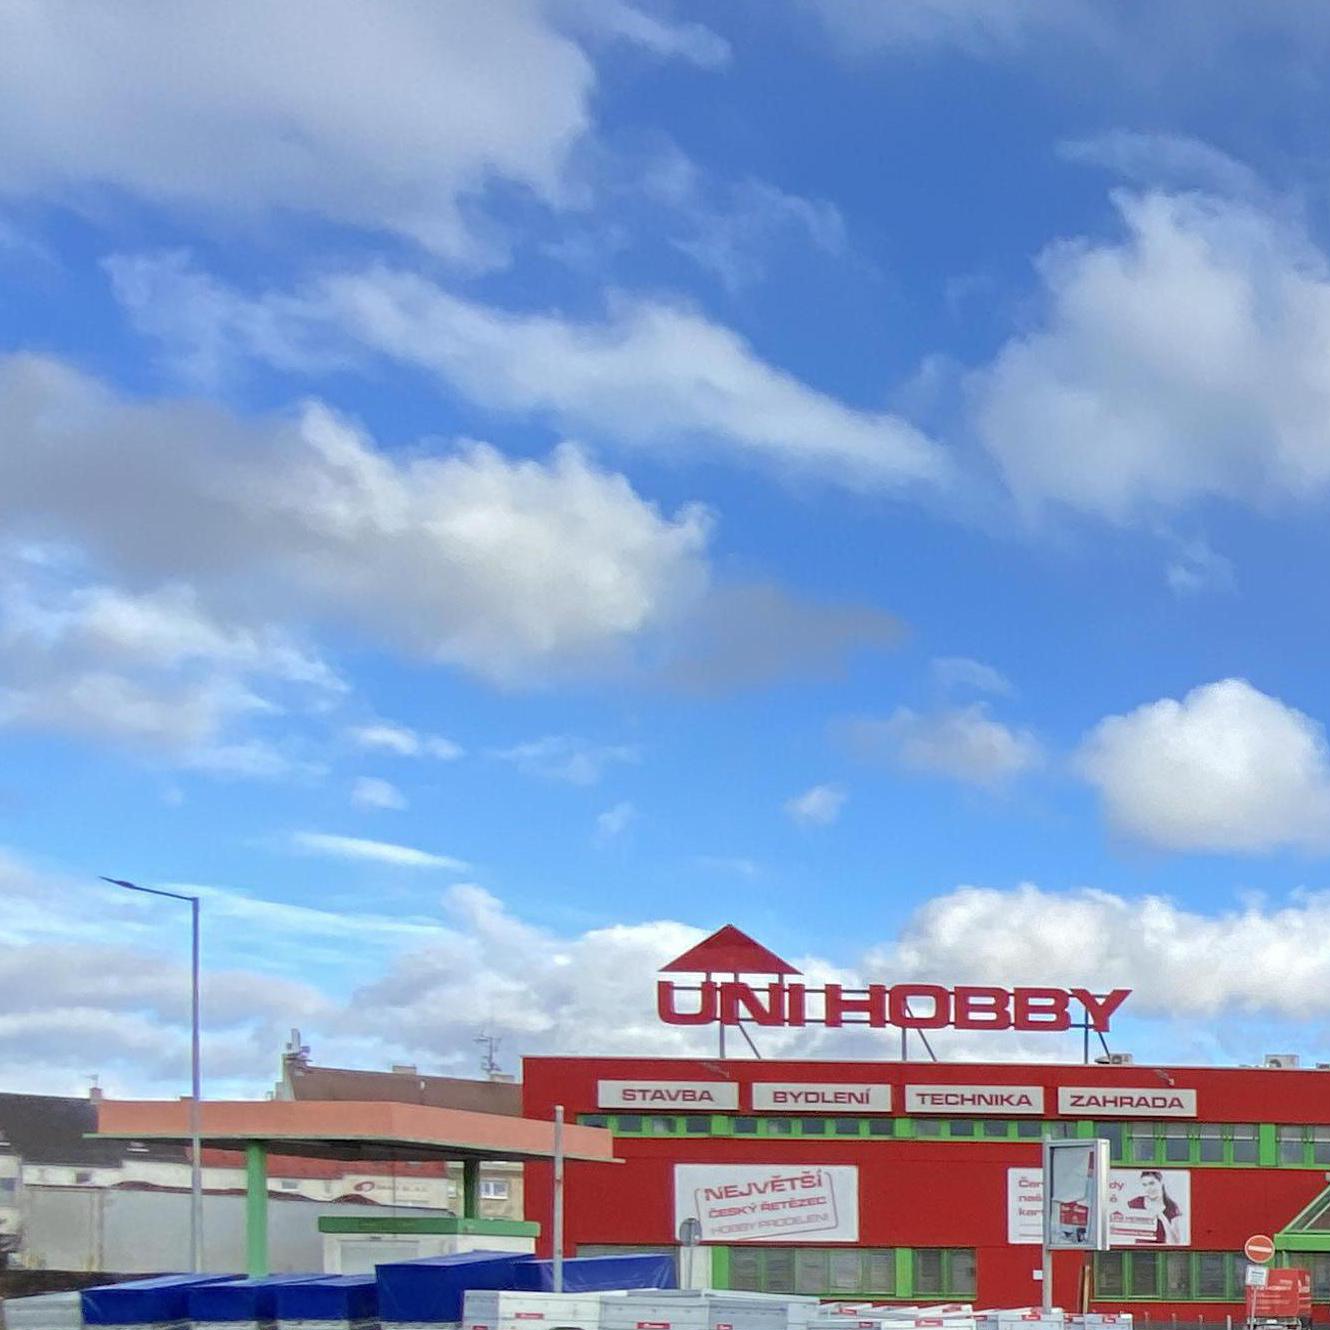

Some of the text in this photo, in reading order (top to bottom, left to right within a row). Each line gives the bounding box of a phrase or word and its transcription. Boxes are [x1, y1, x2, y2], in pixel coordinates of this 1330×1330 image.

[658, 980, 1134, 1032] UNI HOBBY
[622, 1088, 715, 1102] STAVBA
[772, 1088, 871, 1105] BYDLENÍ
[916, 1092, 1033, 1107] TECHNIKA
[1070, 1094, 1184, 1109] ZAHRADA
[704, 1168, 823, 1201] NEJVĚTŠÍ
[708, 1195, 827, 1219] ČESKÝ ŘETĚZEC
